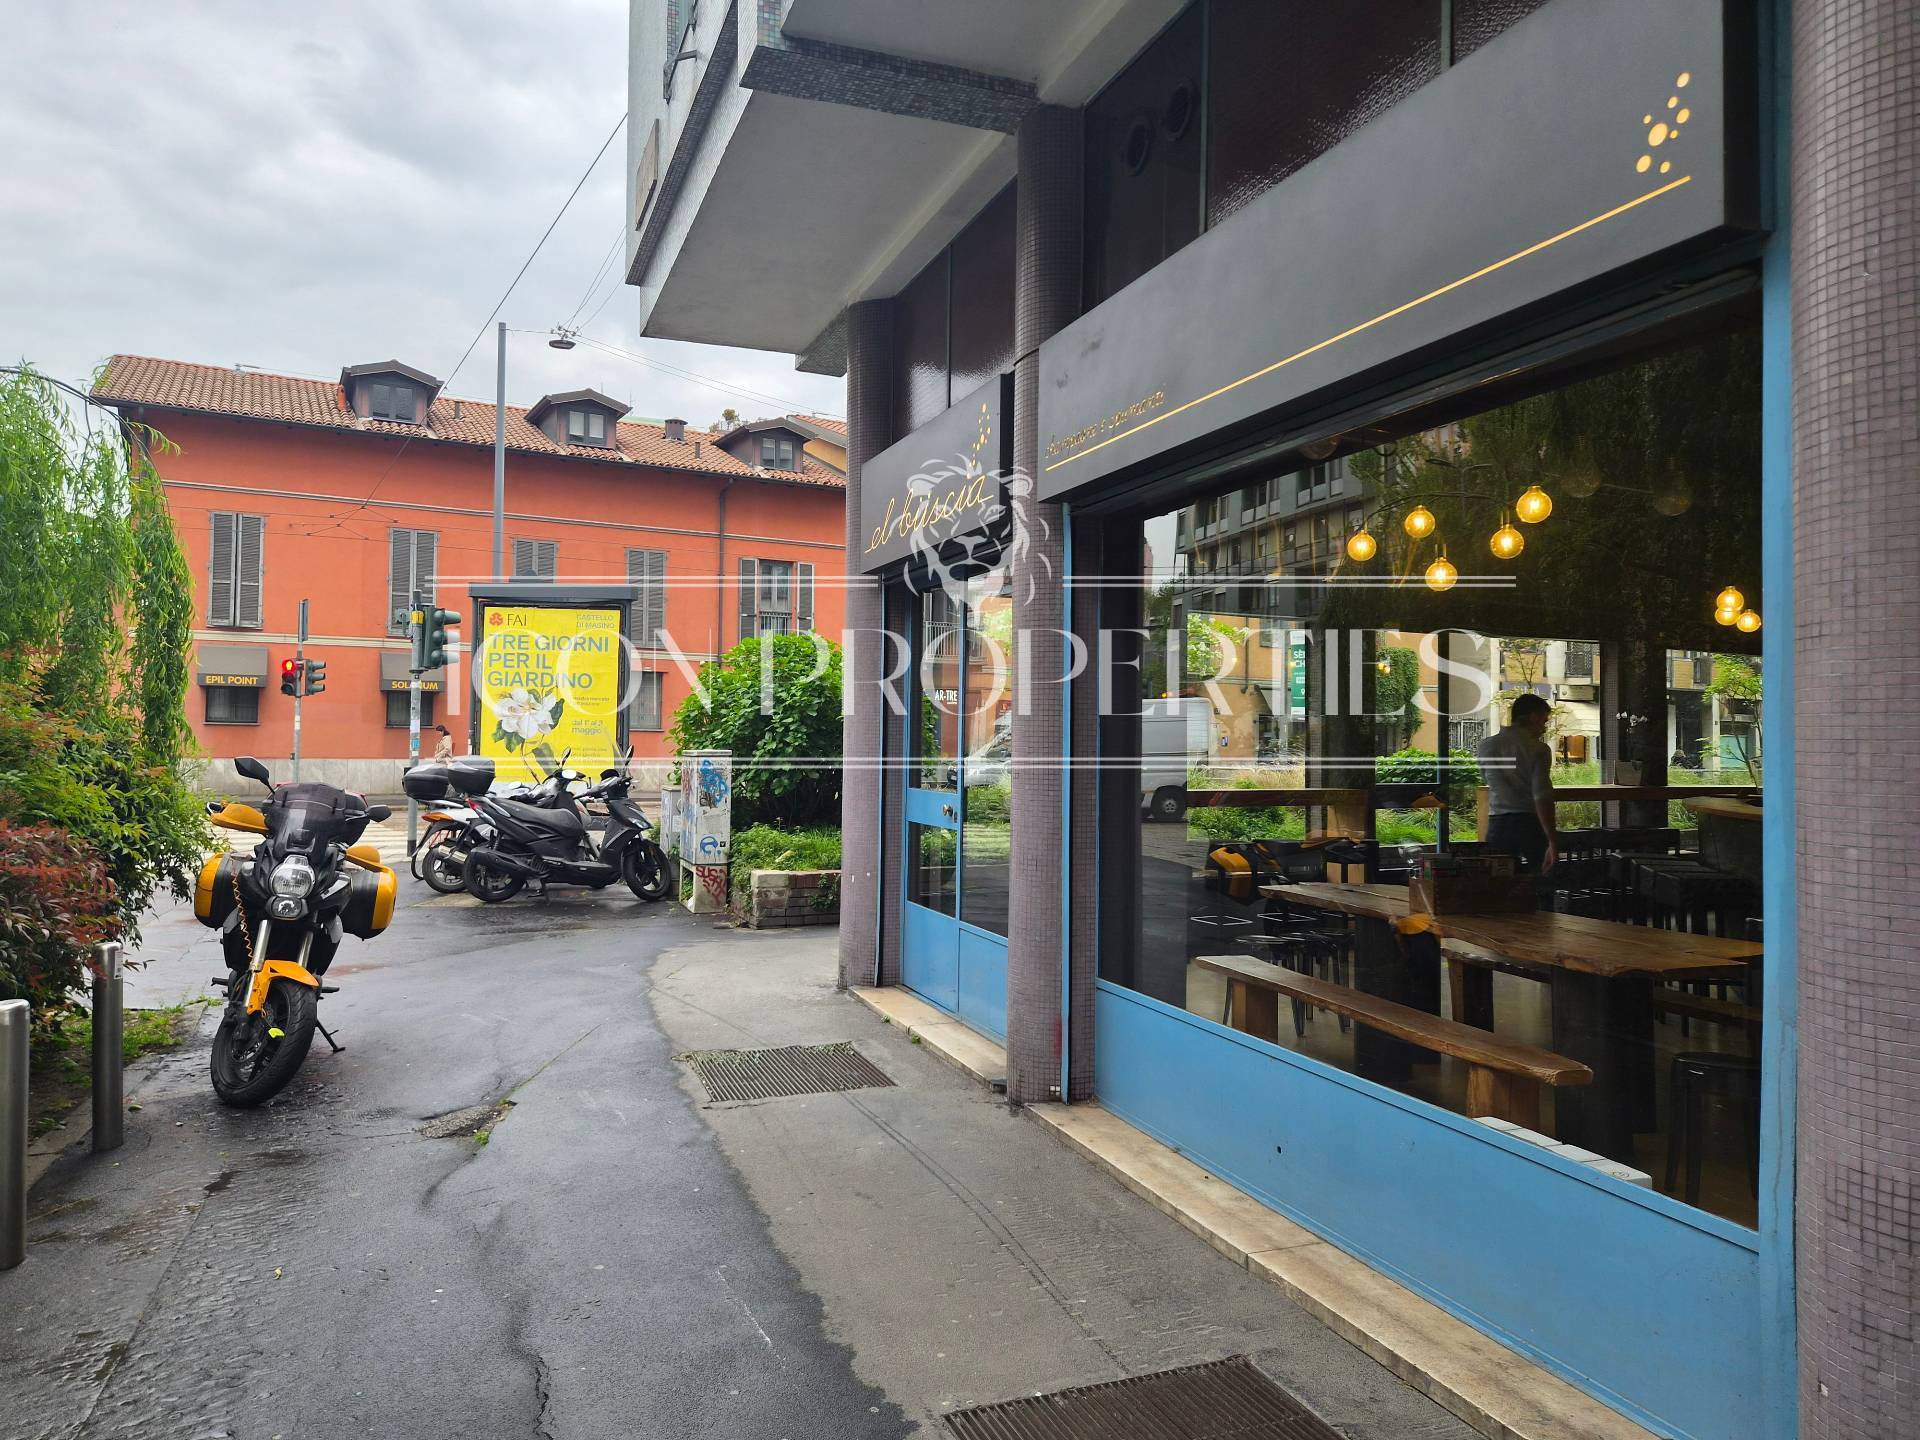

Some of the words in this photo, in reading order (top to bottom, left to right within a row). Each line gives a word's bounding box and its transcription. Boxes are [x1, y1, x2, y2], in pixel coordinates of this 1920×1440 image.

[864, 497, 896, 554] el
[506, 613, 528, 627] FAI
[489, 633, 530, 651] TRE
[535, 635, 609, 653] GIORNI
[488, 652, 529, 669] PER
[535, 653, 552, 670] IL
[205, 675, 225, 684] EPIL
[227, 675, 259, 685] POINT
[487, 670, 593, 689] GIARDINO
